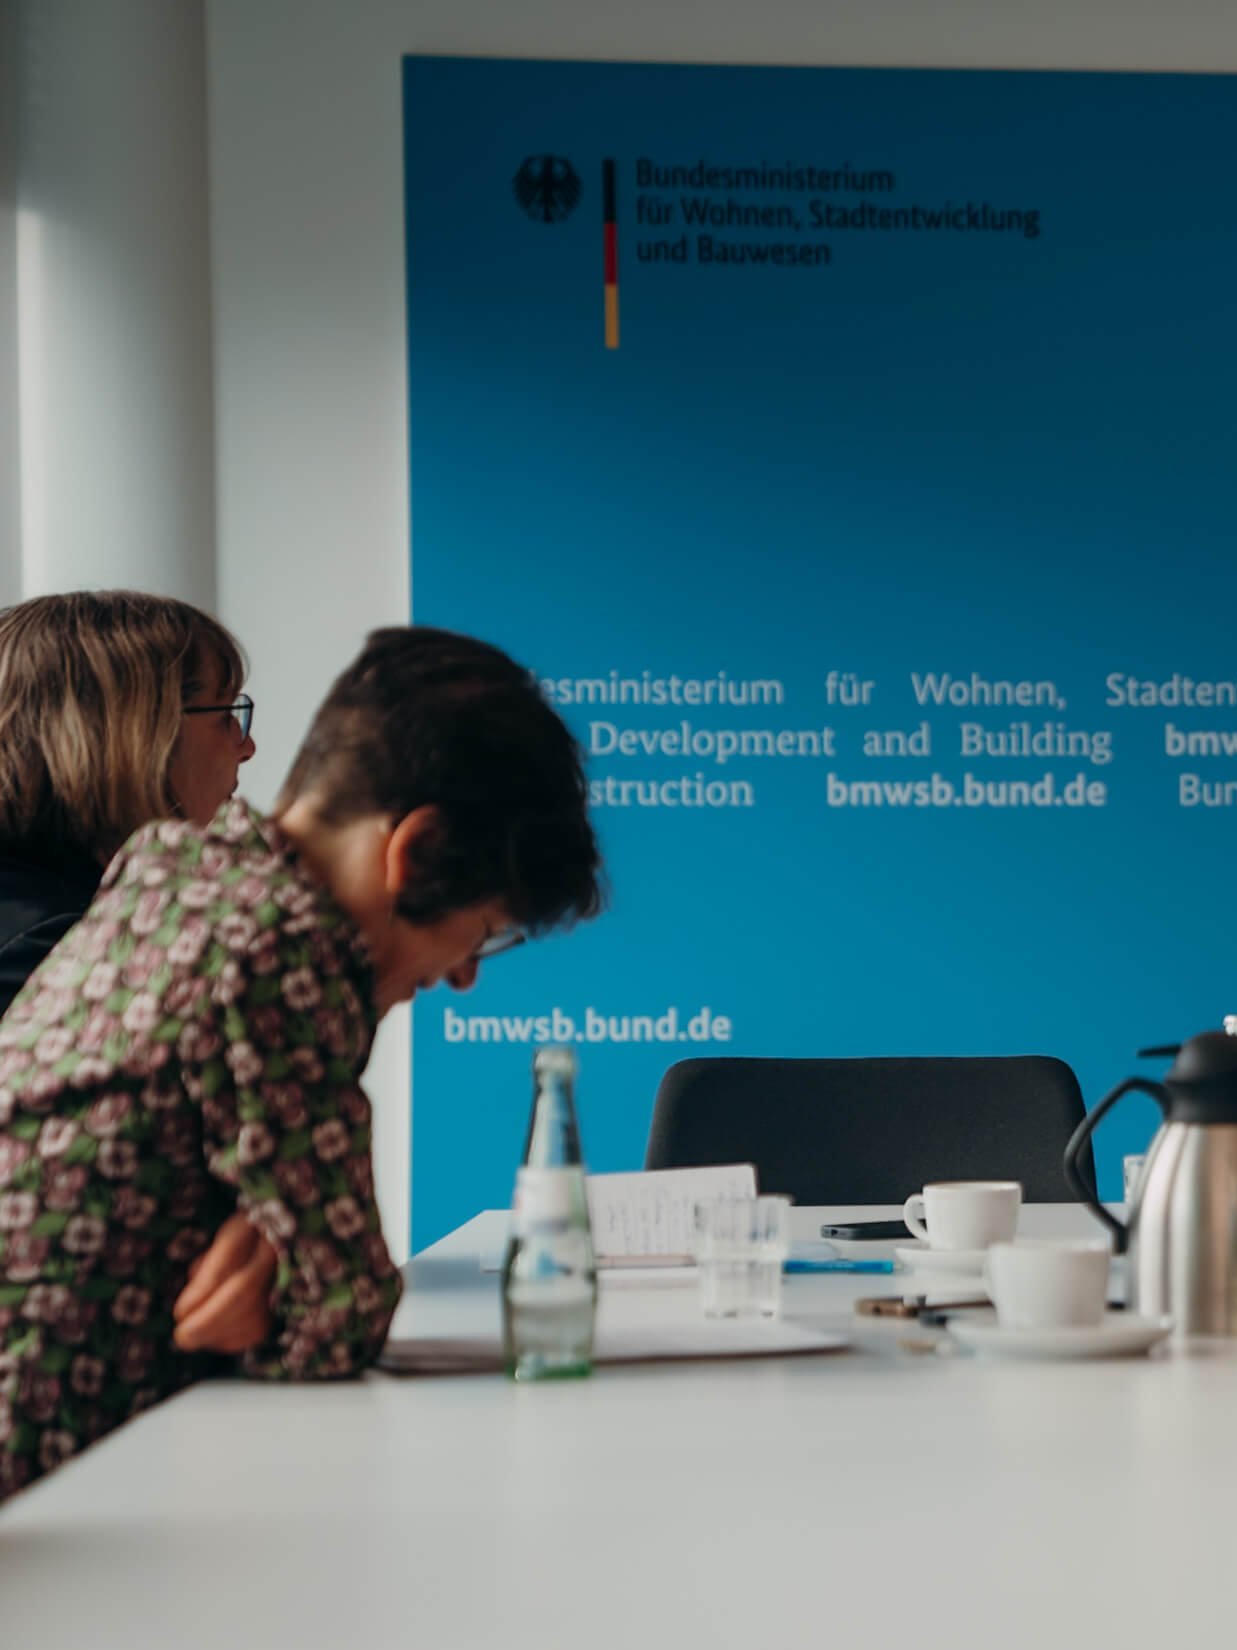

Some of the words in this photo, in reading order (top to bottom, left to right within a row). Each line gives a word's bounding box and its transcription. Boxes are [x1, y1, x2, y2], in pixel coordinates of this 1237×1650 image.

[636, 157, 894, 193] Bundesministerium
[636, 195, 674, 226] für
[680, 197, 801, 232] Wohnen,
[808, 200, 1041, 239] Stadtentwicklung
[636, 234, 687, 263] und
[697, 236, 831, 266] Bauwesen
[530, 669, 784, 706] esministerium
[826, 670, 874, 705] für
[911, 672, 1067, 710] Wohnen,
[588, 719, 836, 765] Development
[863, 720, 931, 757] and
[960, 721, 1113, 765] Building
[588, 771, 754, 807] struction
[826, 772, 1107, 807] bmwsb.bund.de
[444, 1007, 732, 1043] bmwsb.bund.de
